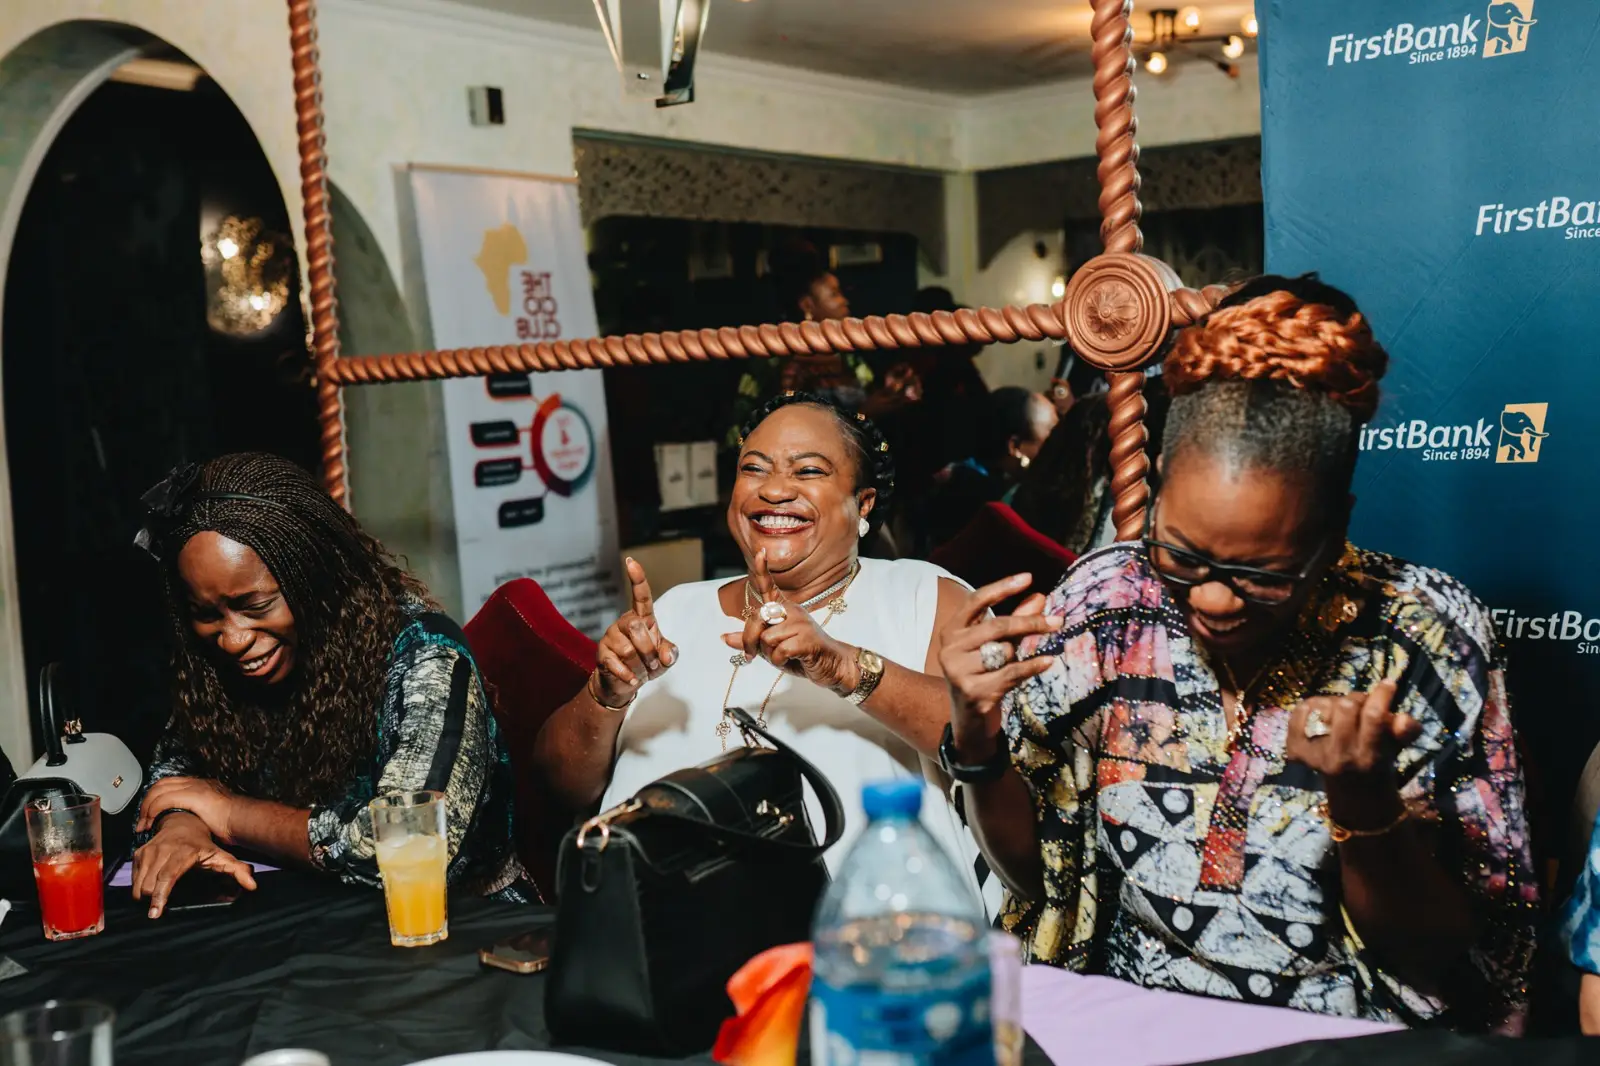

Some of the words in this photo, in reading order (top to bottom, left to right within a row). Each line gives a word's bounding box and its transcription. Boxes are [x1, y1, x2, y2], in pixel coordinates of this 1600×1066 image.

[1327, 13, 1481, 66] FirstBank
[1408, 50, 1444, 65] Since
[1446, 44, 1477, 59] 1894
[1358, 417, 1494, 451] irstBank
[1422, 448, 1458, 462] Since
[1460, 447, 1490, 460] 1894
[1576, 641, 1600, 654] Sin
